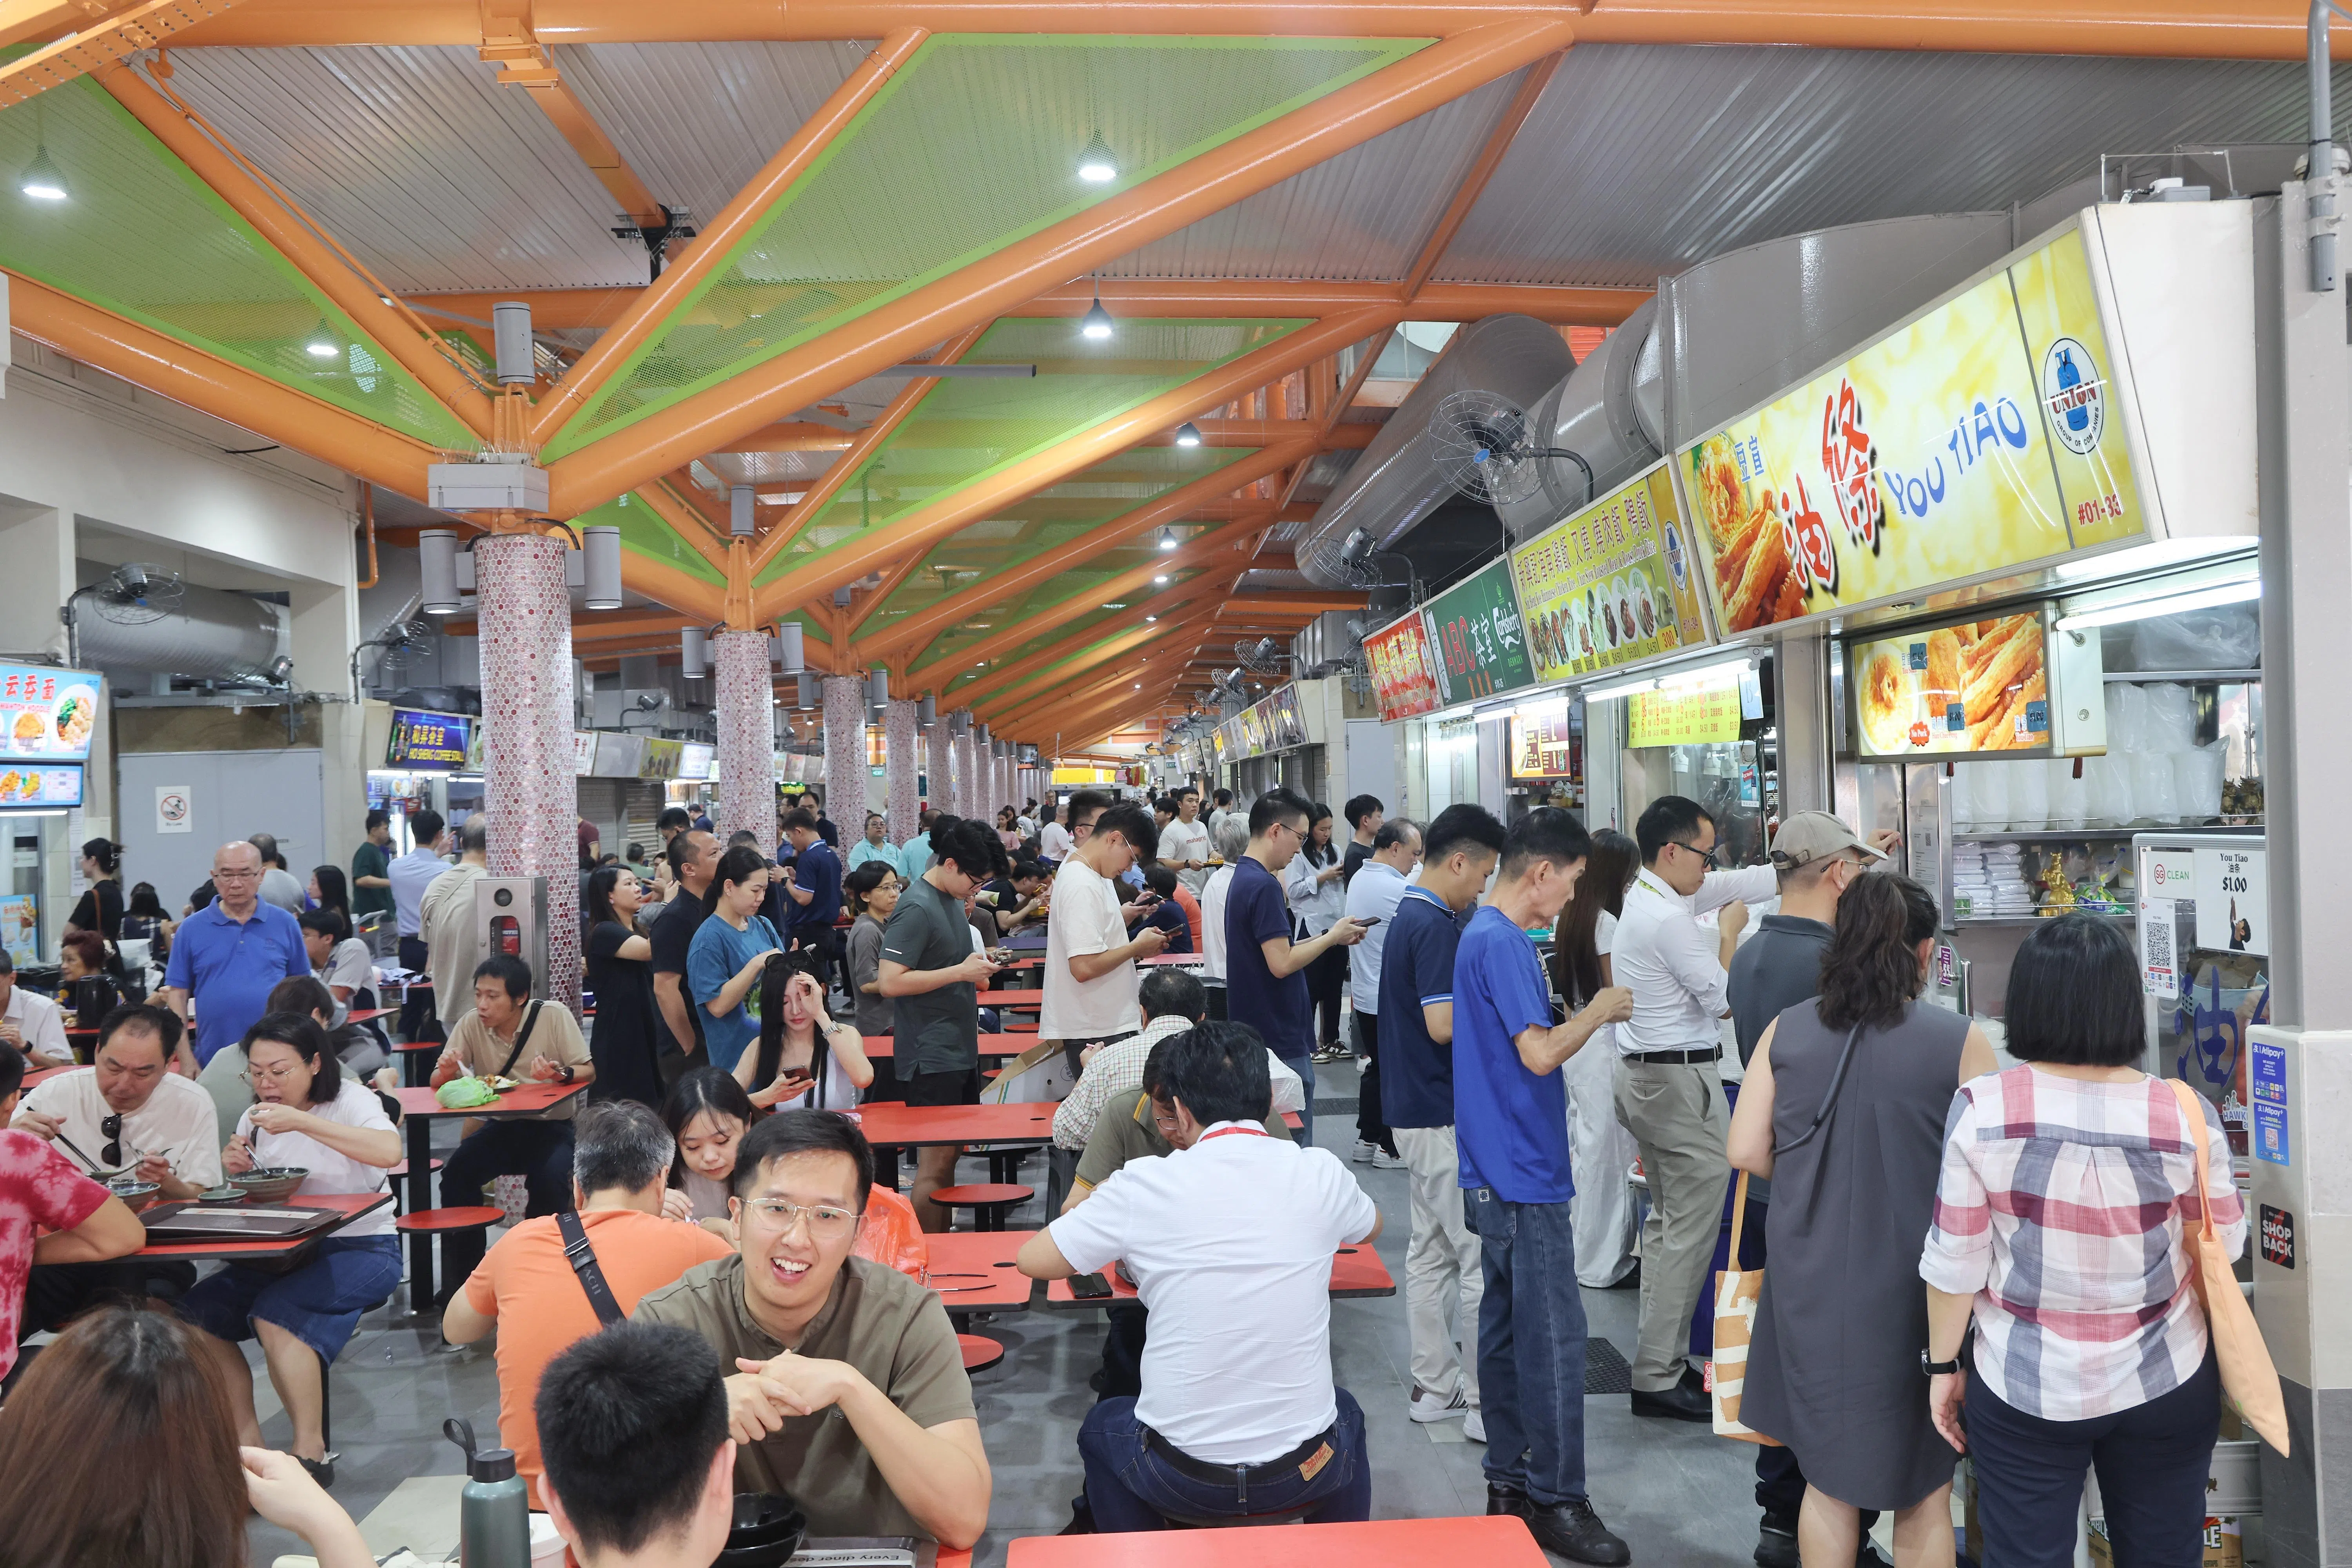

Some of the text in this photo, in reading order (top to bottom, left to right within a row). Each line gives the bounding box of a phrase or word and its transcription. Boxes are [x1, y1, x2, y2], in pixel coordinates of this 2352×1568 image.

[2051, 379, 2097, 414] UNION
[2056, 420, 2072, 443] GROUP
[2083, 406, 2100, 446] COMANIES
[1884, 397, 2027, 517] YOU TIAO
[2078, 493, 2122, 526] #01-33
[1577, 571, 1586, 586] Char
[1585, 568, 1594, 583] Siew
[1593, 559, 1609, 579] Roasted
[1607, 556, 1619, 573] Meat
[1621, 550, 1635, 567] Roast
[1633, 540, 1647, 561] Duck
[1644, 537, 1657, 557] Rice
[1668, 548, 1682, 565] UNION
[1493, 601, 1521, 651] Carlsberg
[1683, 617, 1698, 632] #01-34
[1441, 615, 1475, 678] ABC
[1471, 613, 1497, 669] 茶室
[1662, 630, 1675, 648] 300
[1628, 646, 1639, 659] $6.00
[1646, 641, 1659, 655] $4.50
[1508, 654, 1523, 667] DENMARK
[1599, 656, 1610, 668] $4.50
[1612, 652, 1623, 663] $4.50
[0, 675, 55, 701] 云吞面
[1186, 835, 1206, 844] mahagrid
[2220, 853, 2248, 862] You Tiao
[2167, 870, 2189, 880] CLEAN
[2228, 863, 2240, 874] 油条
[2222, 876, 2247, 893] $1.00
[2223, 1111, 2248, 1120] HAWK
[2262, 1220, 2292, 1240] SHOP
[2263, 1235, 2292, 1258] BACK
[576, 1251, 601, 1294] CACH
[2203, 1526, 2221, 1548] LE
